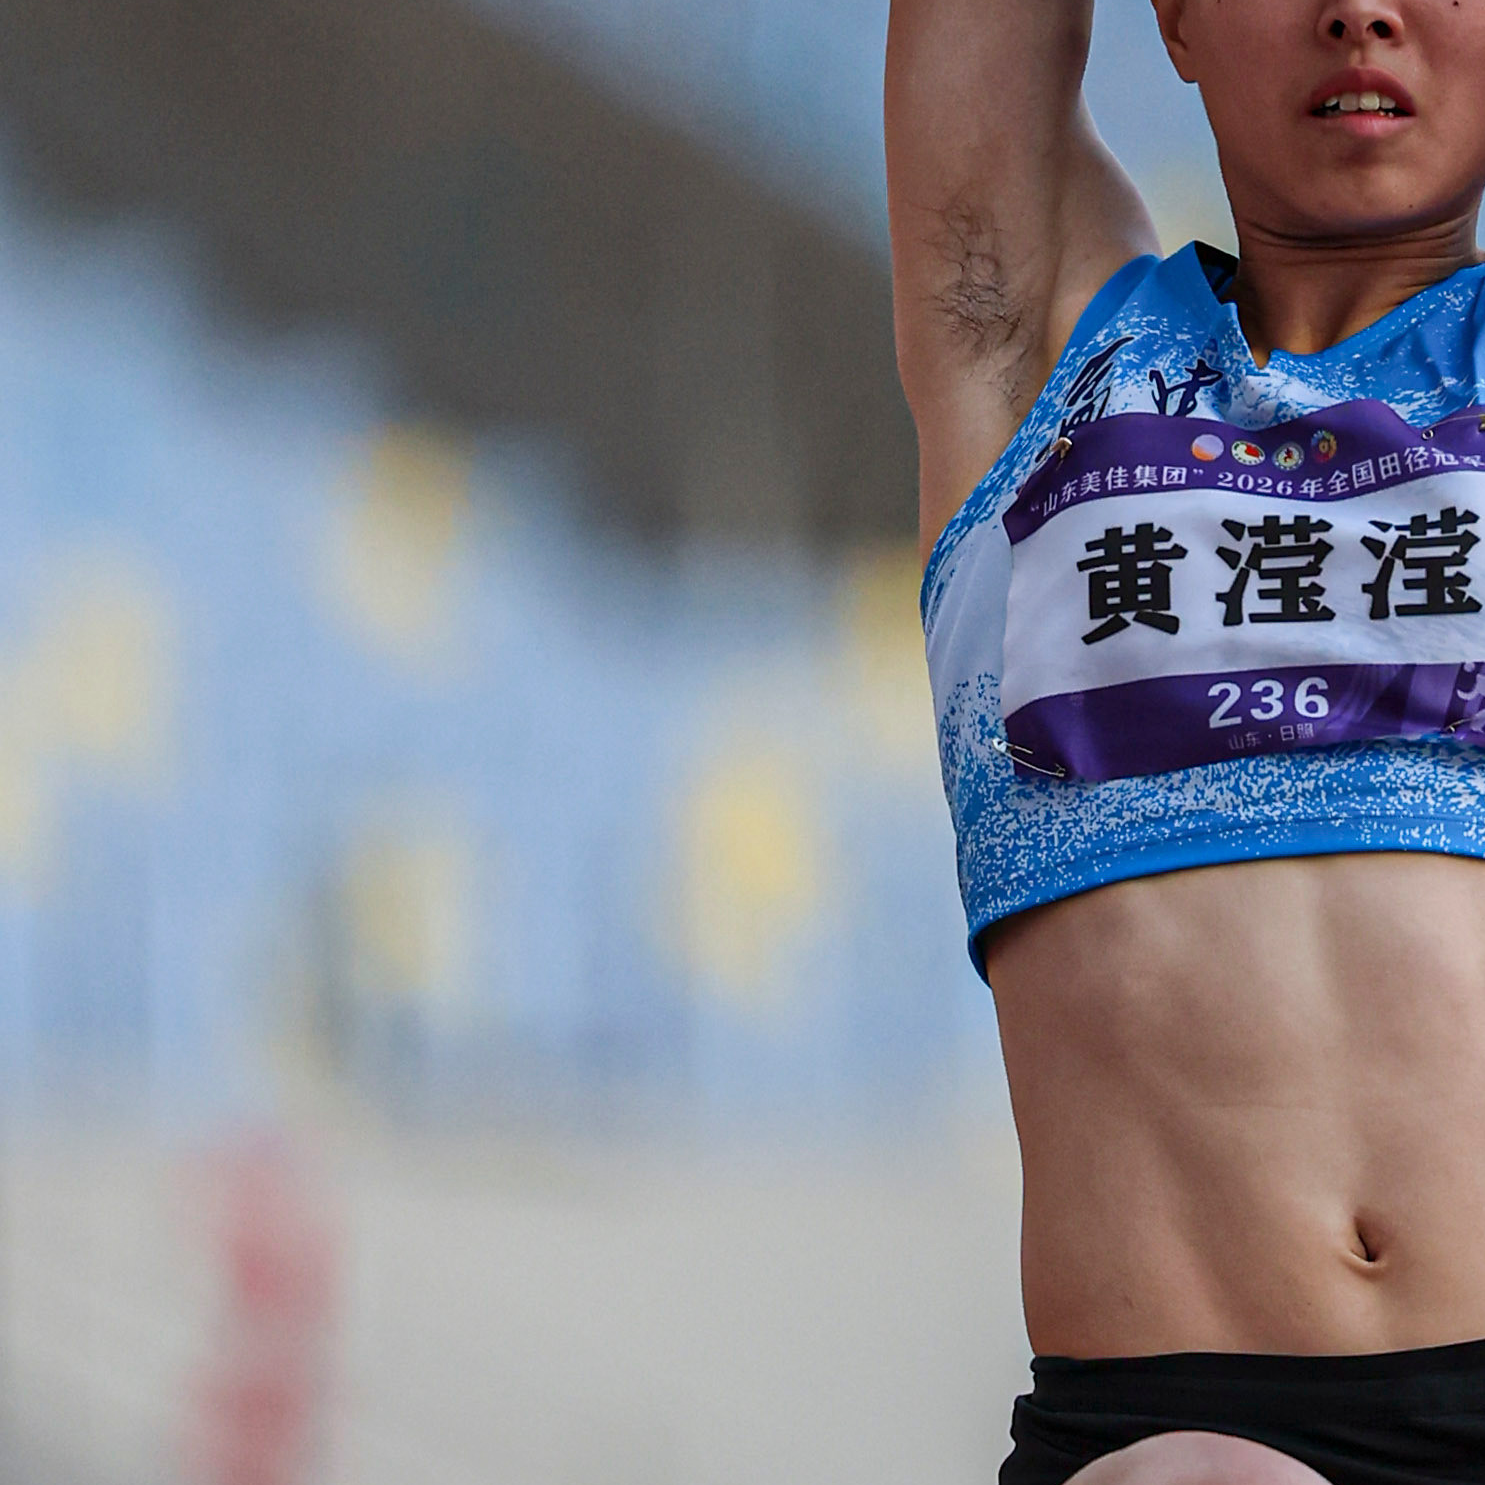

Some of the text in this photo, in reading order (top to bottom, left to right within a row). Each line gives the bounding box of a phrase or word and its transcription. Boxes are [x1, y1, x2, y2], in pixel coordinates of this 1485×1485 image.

[1076, 506, 1483, 645] 黄滢滢
[1207, 676, 1330, 729] 236
